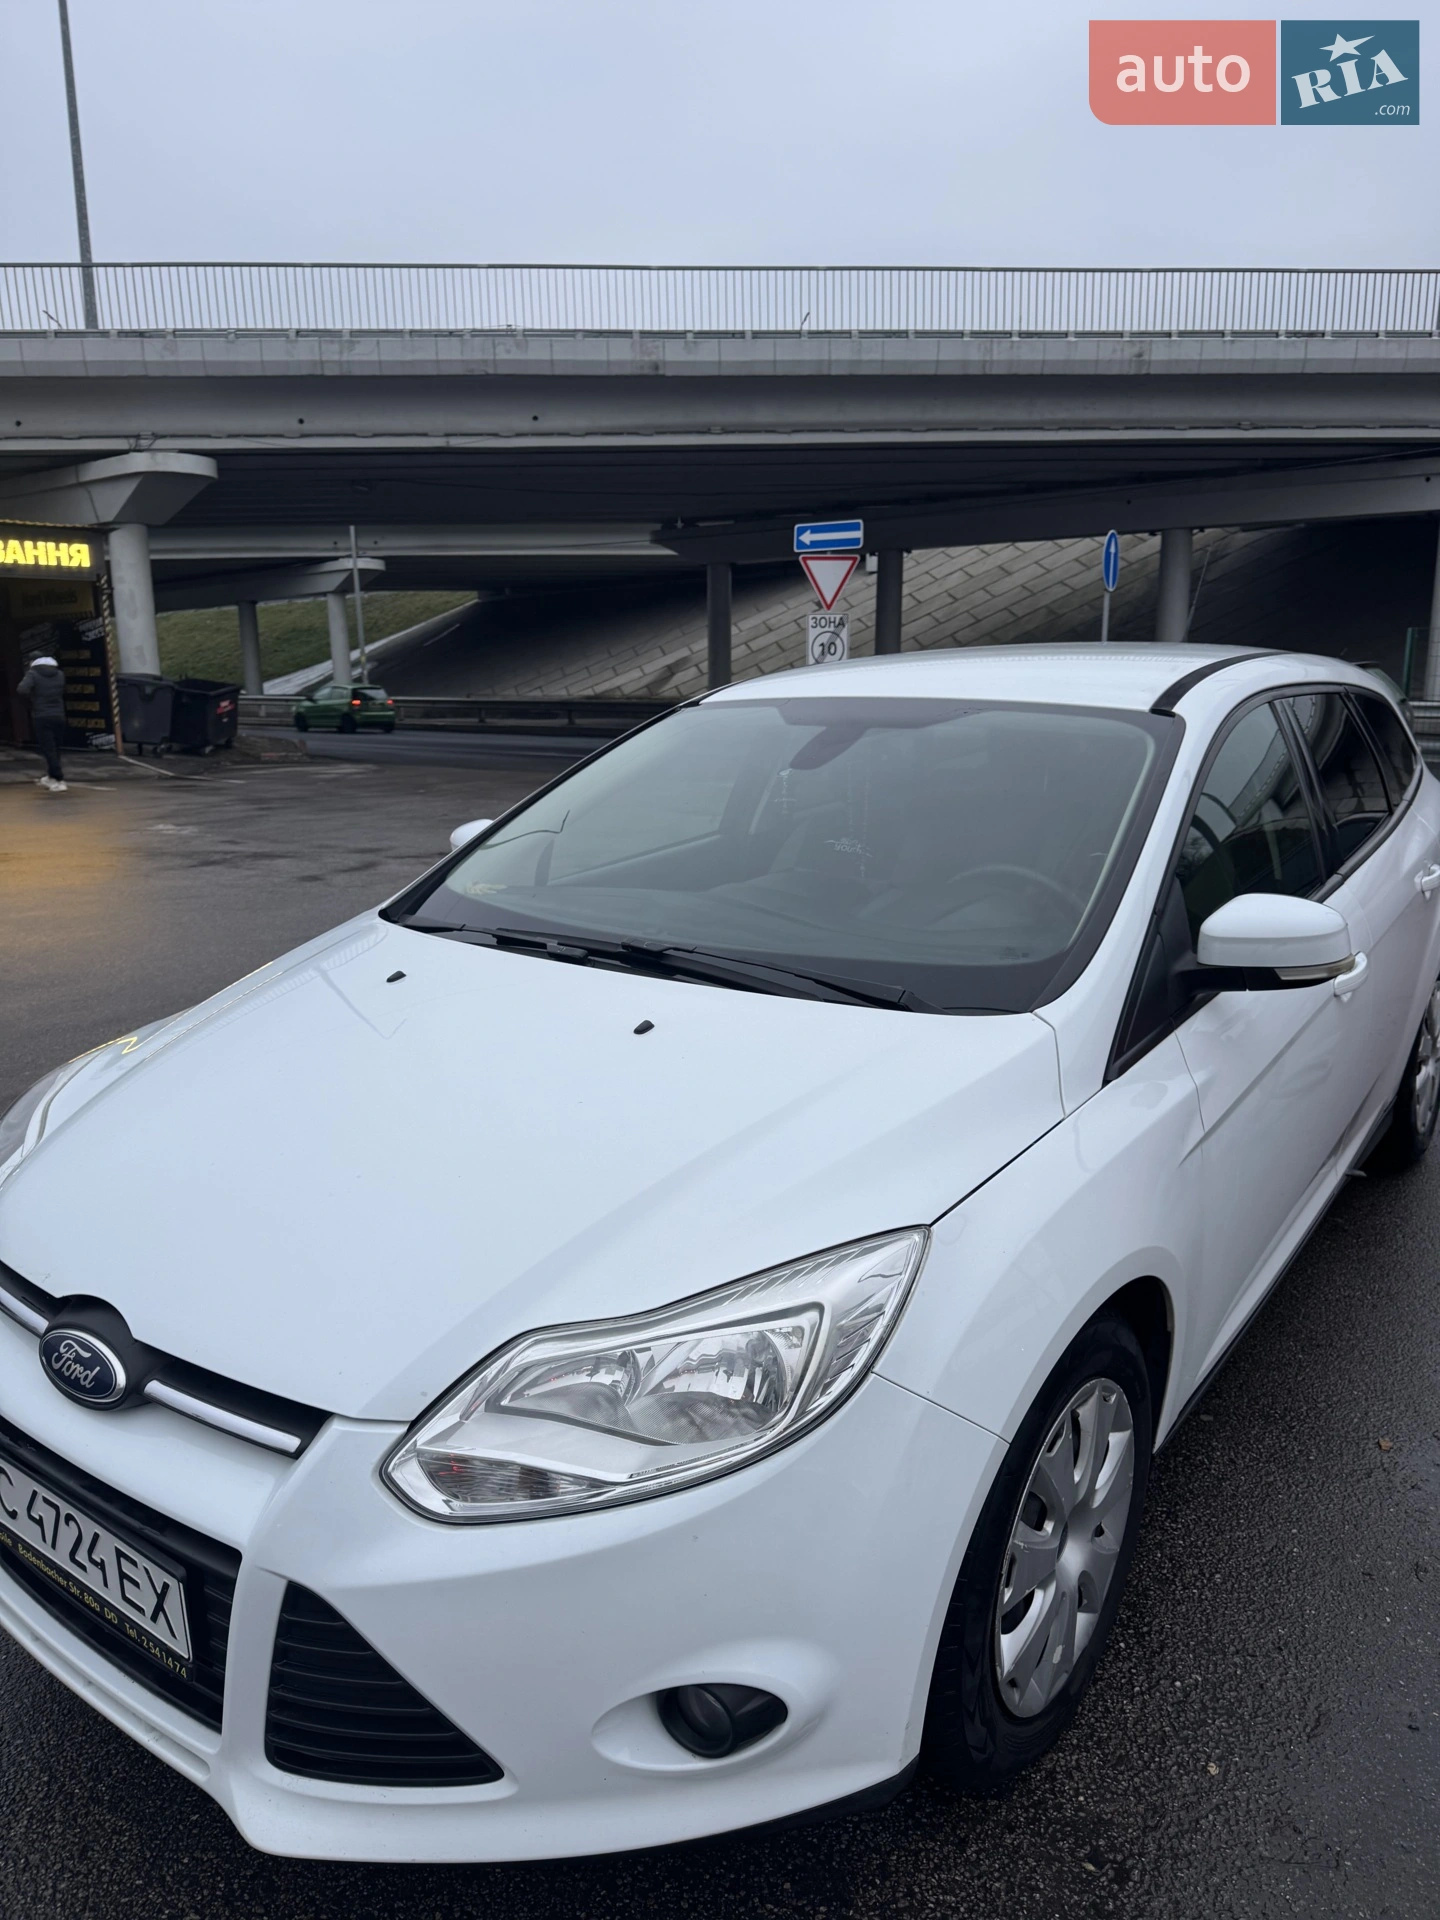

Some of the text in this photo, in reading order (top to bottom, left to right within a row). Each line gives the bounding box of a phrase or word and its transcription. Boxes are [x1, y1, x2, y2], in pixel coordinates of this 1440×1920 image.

[810, 616, 846, 629] ЗОНА
[819, 641, 837, 657] 10
[51, 1339, 101, 1389] Ford
[26, 1488, 110, 1590] 4724
[114, 1545, 179, 1641] EX
[104, 1607, 119, 1625] DD
